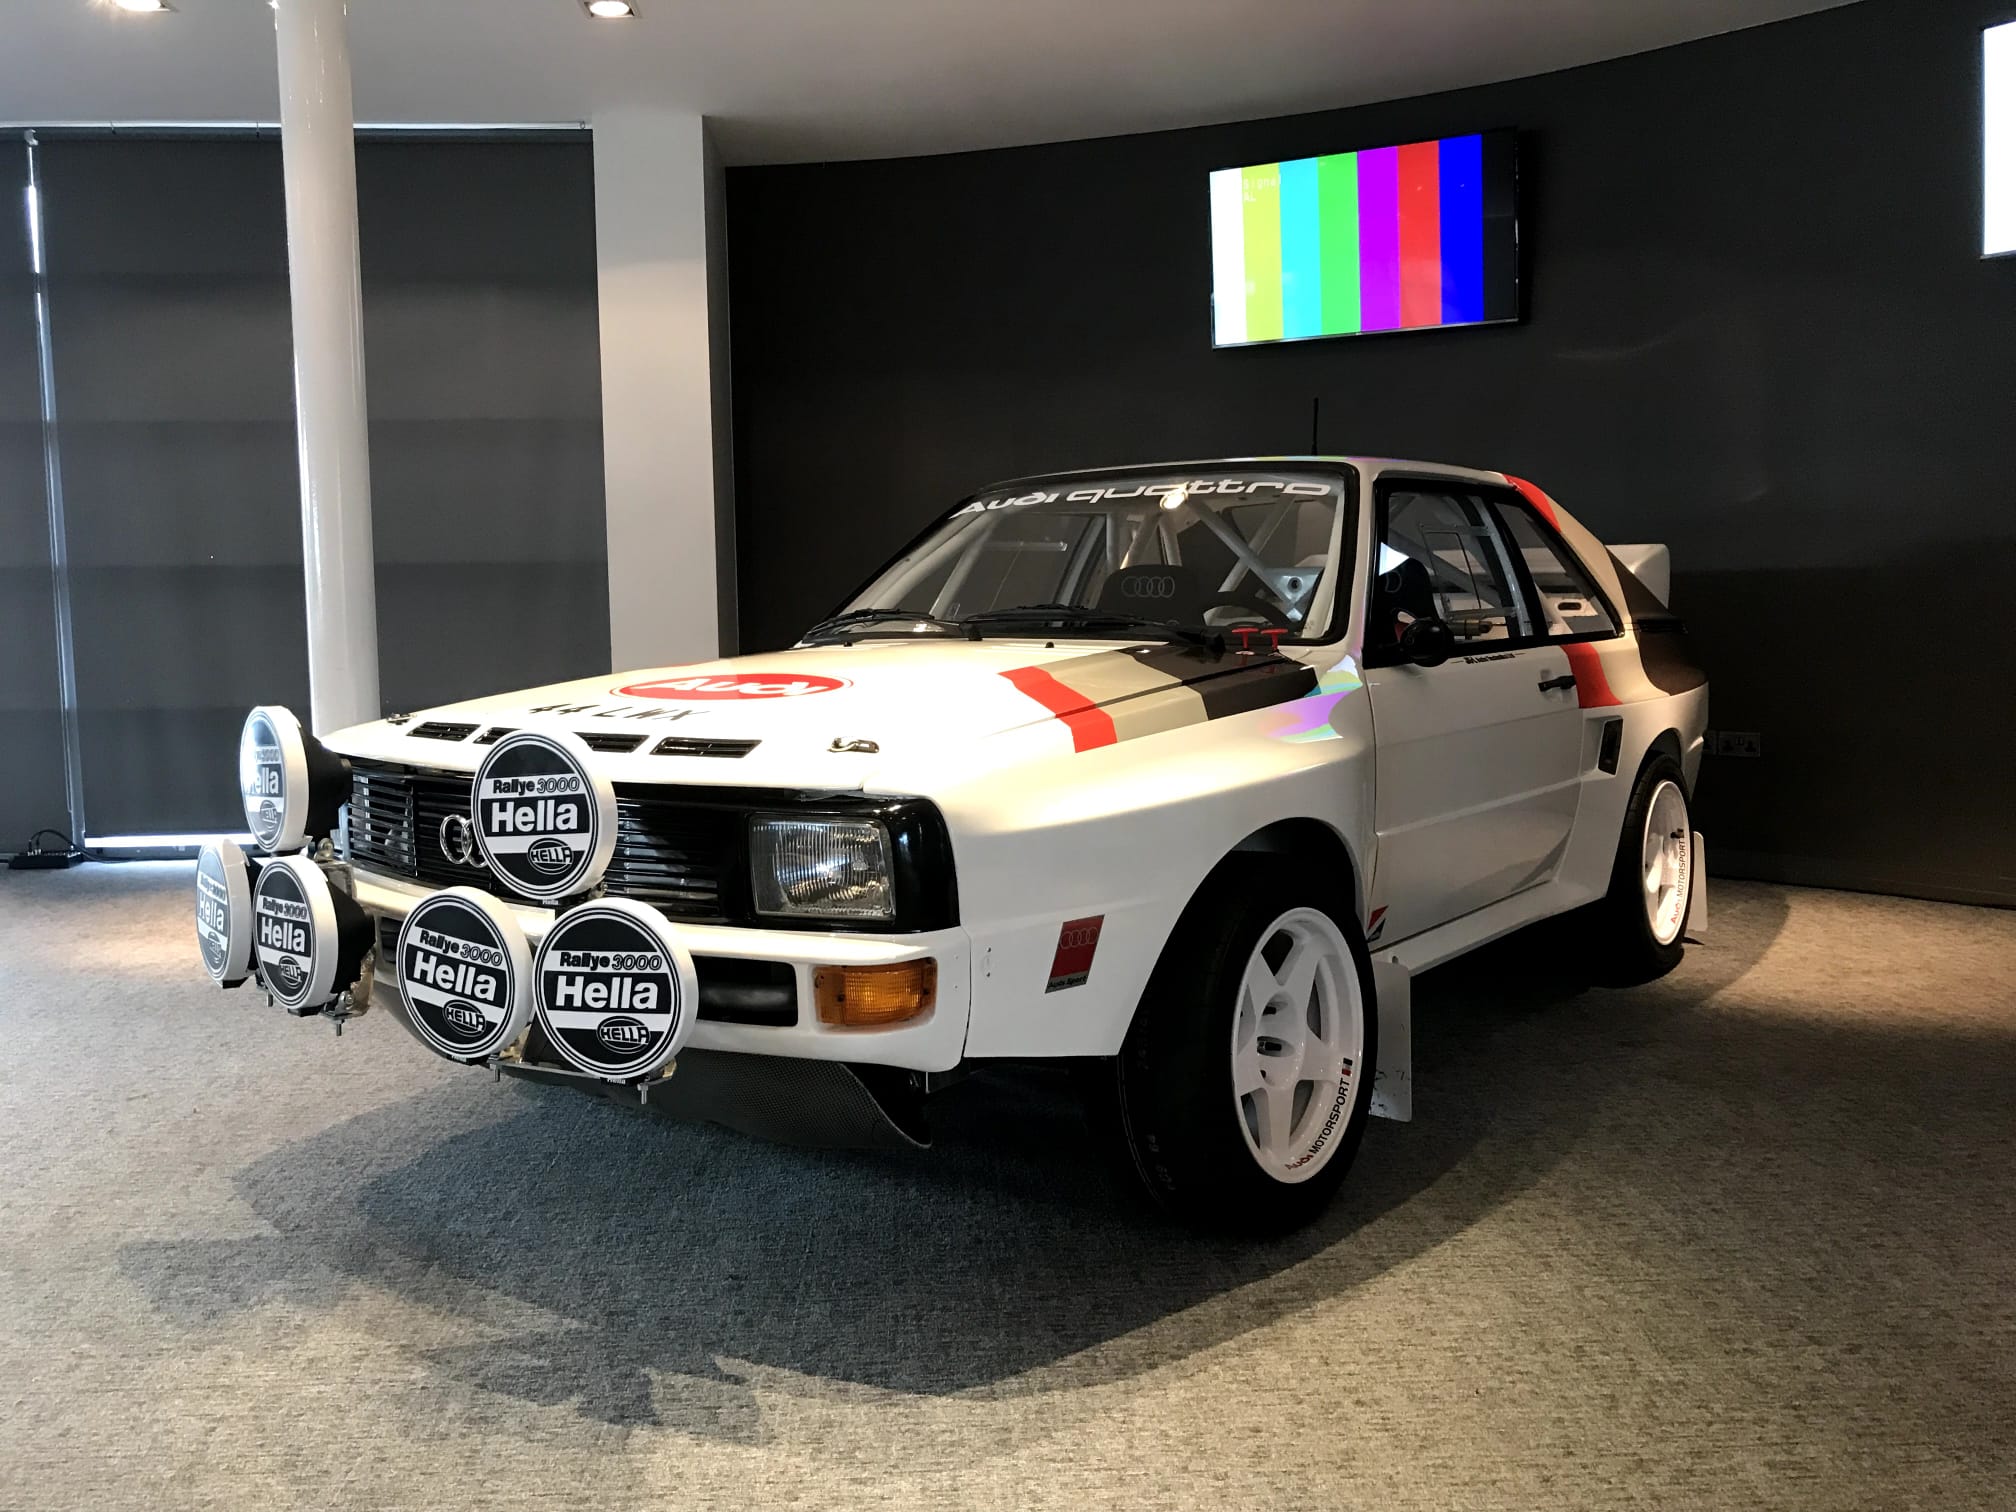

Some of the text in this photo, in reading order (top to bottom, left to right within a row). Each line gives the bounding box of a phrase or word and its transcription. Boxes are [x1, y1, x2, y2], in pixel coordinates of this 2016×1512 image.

[949, 481, 1332, 519] Audi quattro
[493, 777, 581, 795] Rallye 3000
[491, 799, 578, 832] Hella
[531, 846, 573, 865] HELLA
[199, 891, 225, 932] Hella
[263, 897, 308, 919] Rallye 3000
[261, 917, 306, 952] Hella
[420, 930, 503, 966] Rallye 3000
[413, 951, 497, 1001] Hella
[560, 952, 663, 971] Rallye 3000
[556, 975, 659, 1010] Hella
[446, 1007, 486, 1031] HELLA
[600, 1026, 650, 1045] HELLA
[1309, 1077, 1350, 1155] MOTORSPORT
